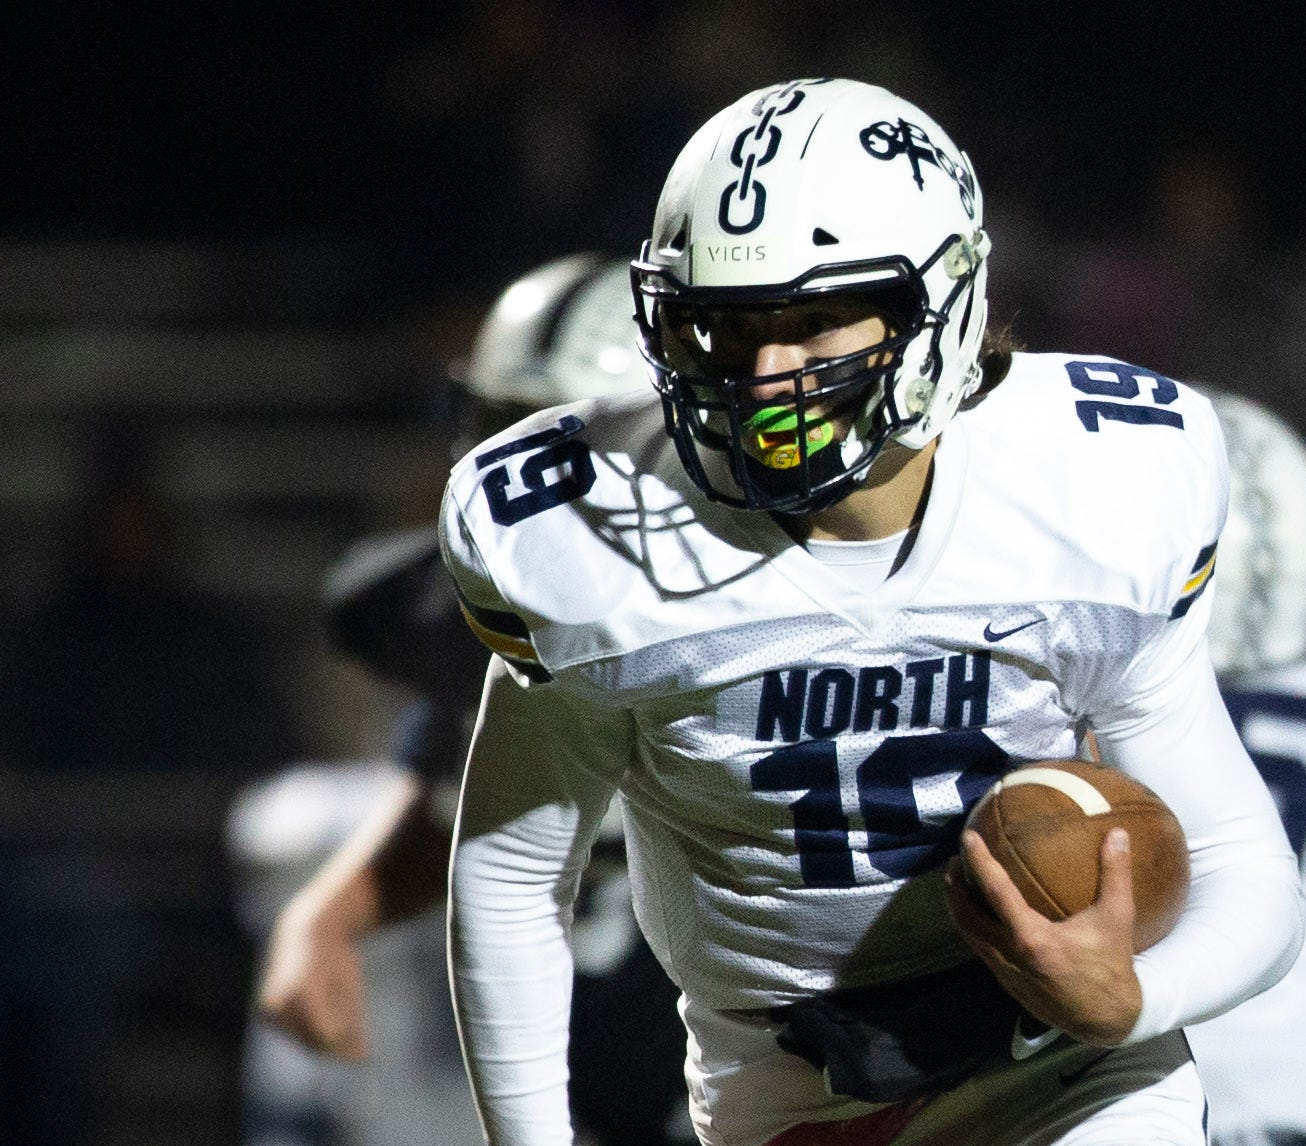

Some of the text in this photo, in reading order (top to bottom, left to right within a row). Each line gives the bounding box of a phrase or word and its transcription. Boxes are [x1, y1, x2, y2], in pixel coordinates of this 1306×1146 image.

[707, 245, 766, 262] VICIS
[1064, 360, 1185, 433] 19
[475, 414, 597, 527] 19
[755, 650, 991, 742] NORTH
